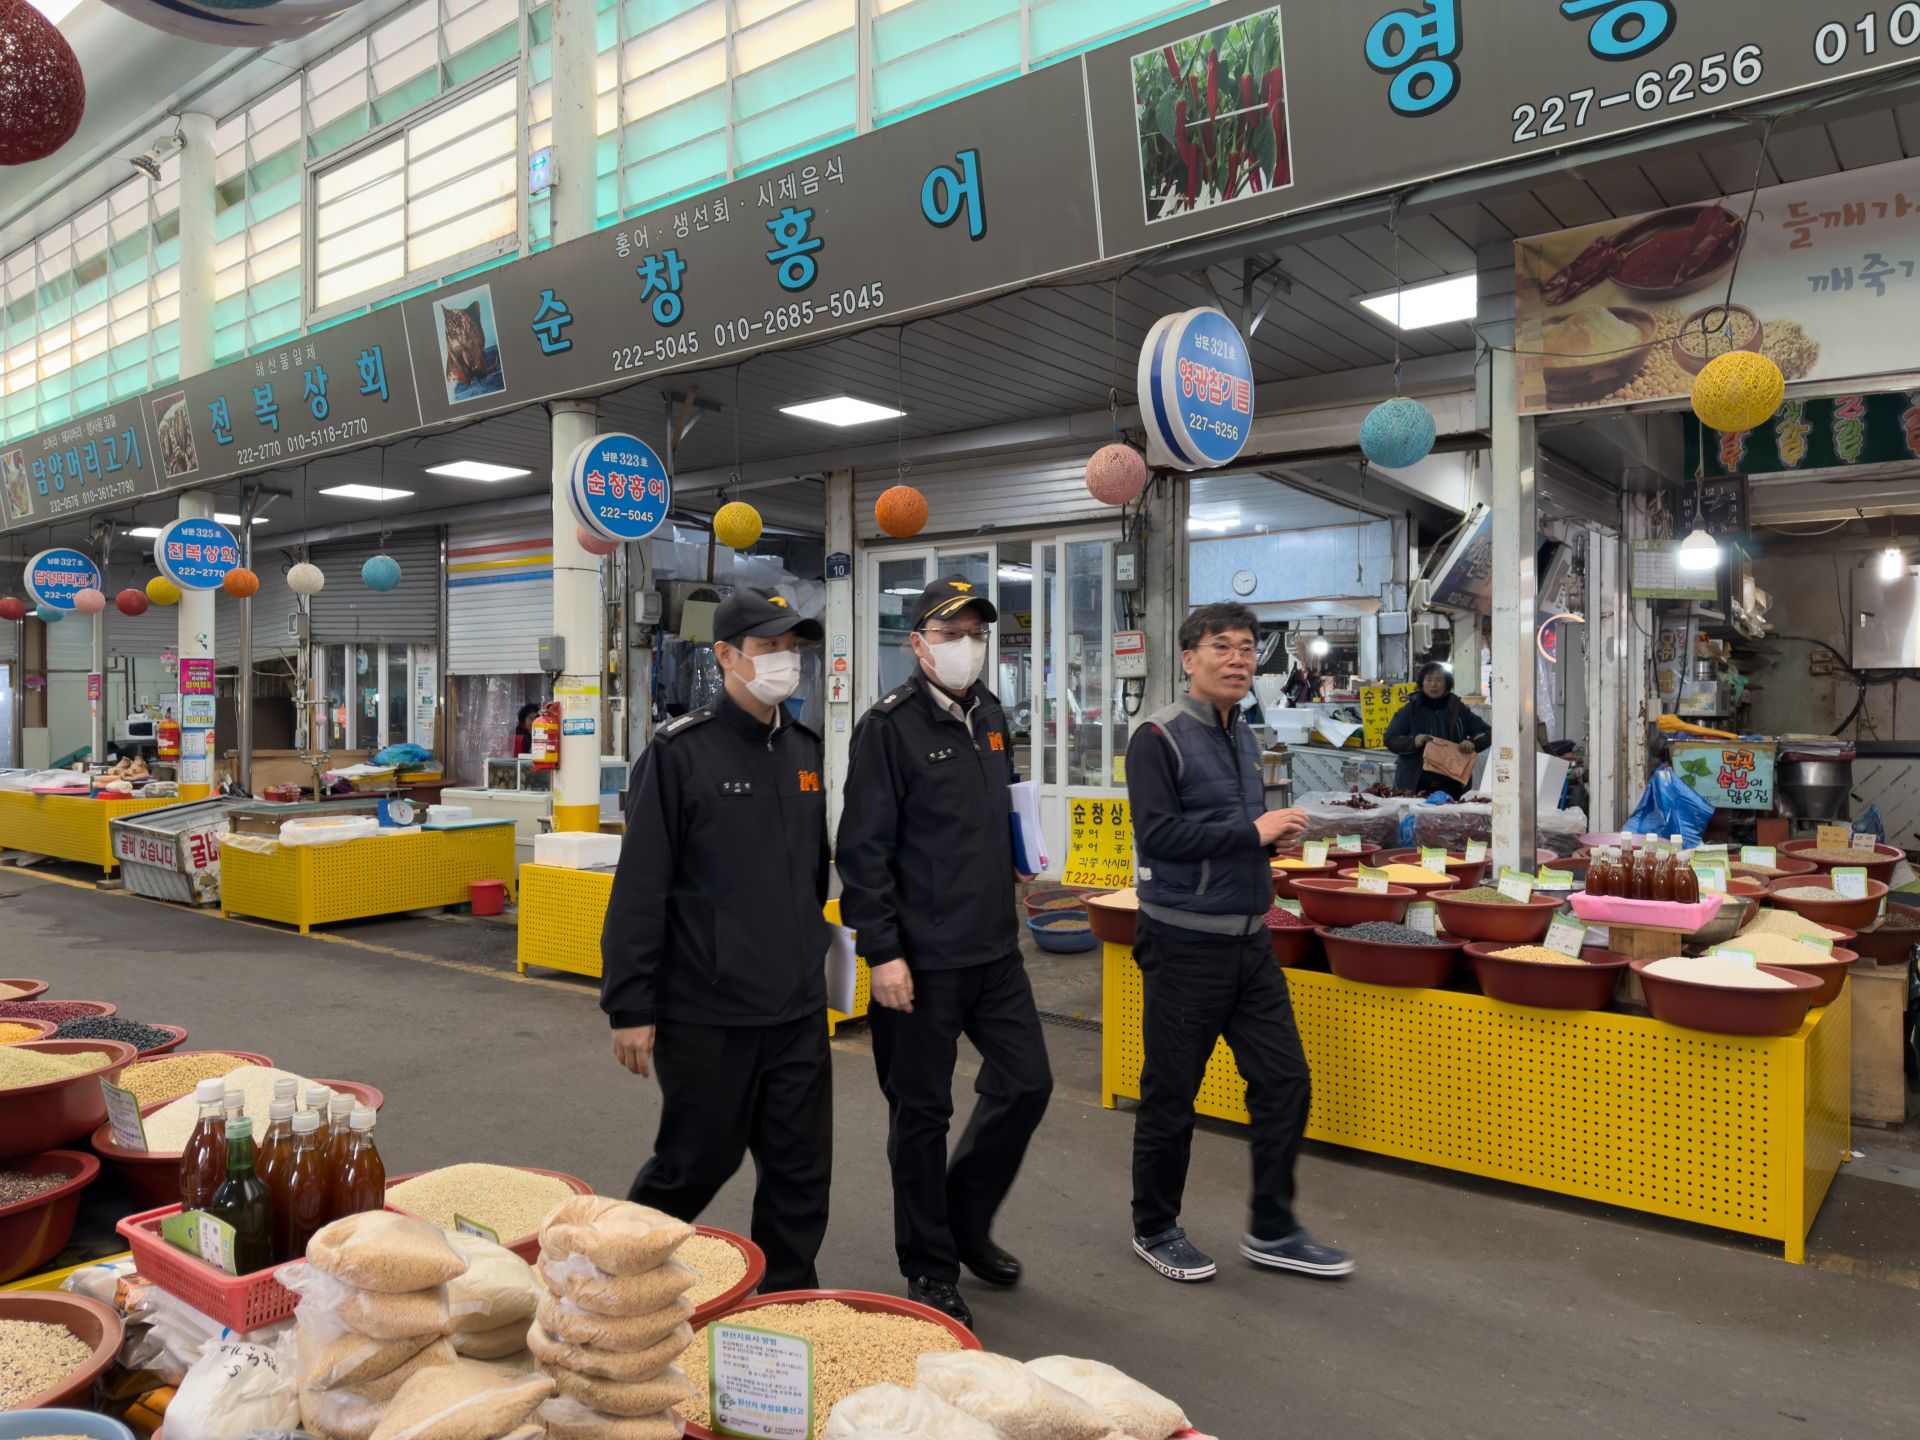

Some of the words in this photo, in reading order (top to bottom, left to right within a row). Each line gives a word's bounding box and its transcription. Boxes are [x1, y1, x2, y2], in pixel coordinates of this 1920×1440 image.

[1512, 44, 1764, 143] 227-6256
[616, 225, 650, 258] 홍어
[673, 197, 731, 240] 생선회
[757, 155, 845, 209] 시제음식
[1782, 193, 1920, 250] 들깨가
[612, 332, 699, 372] 222-5045
[714, 282, 885, 348] 010-2685-5045
[1194, 332, 1209, 351] 남문
[1210, 337, 1237, 361] 321호
[1179, 357, 1250, 414] 영광참기름
[1189, 413, 1239, 441] 227-6256
[237, 441, 281, 465] 222-2770
[287, 417, 368, 453] 010-5118-2770
[32, 424, 143, 496] 담양머리고기
[602, 451, 618, 463] 남문
[619, 452, 649, 468] 323호
[49, 495, 79, 513] 232-0576
[82, 479, 135, 505] 010-3612-7790
[587, 469, 665, 503] 순창홍어
[600, 506, 654, 522] 222-5045
[168, 543, 238, 564] 전복상회
[178, 566, 225, 577] 222-2770
[833, 565, 845, 577] 10
[44, 591, 75, 600] 232-05
[1722, 749, 1756, 771] 단골
[1717, 765, 1763, 789] 손님이
[1727, 789, 1752, 805] 많은
[1754, 789, 1769, 803] 집
[1073, 803, 1133, 826] 순창상
[121, 833, 136, 858] 굴비
[1114, 830, 1133, 840] 민
[1113, 844, 1133, 854] 홍
[1101, 858, 1130, 870] 사시미
